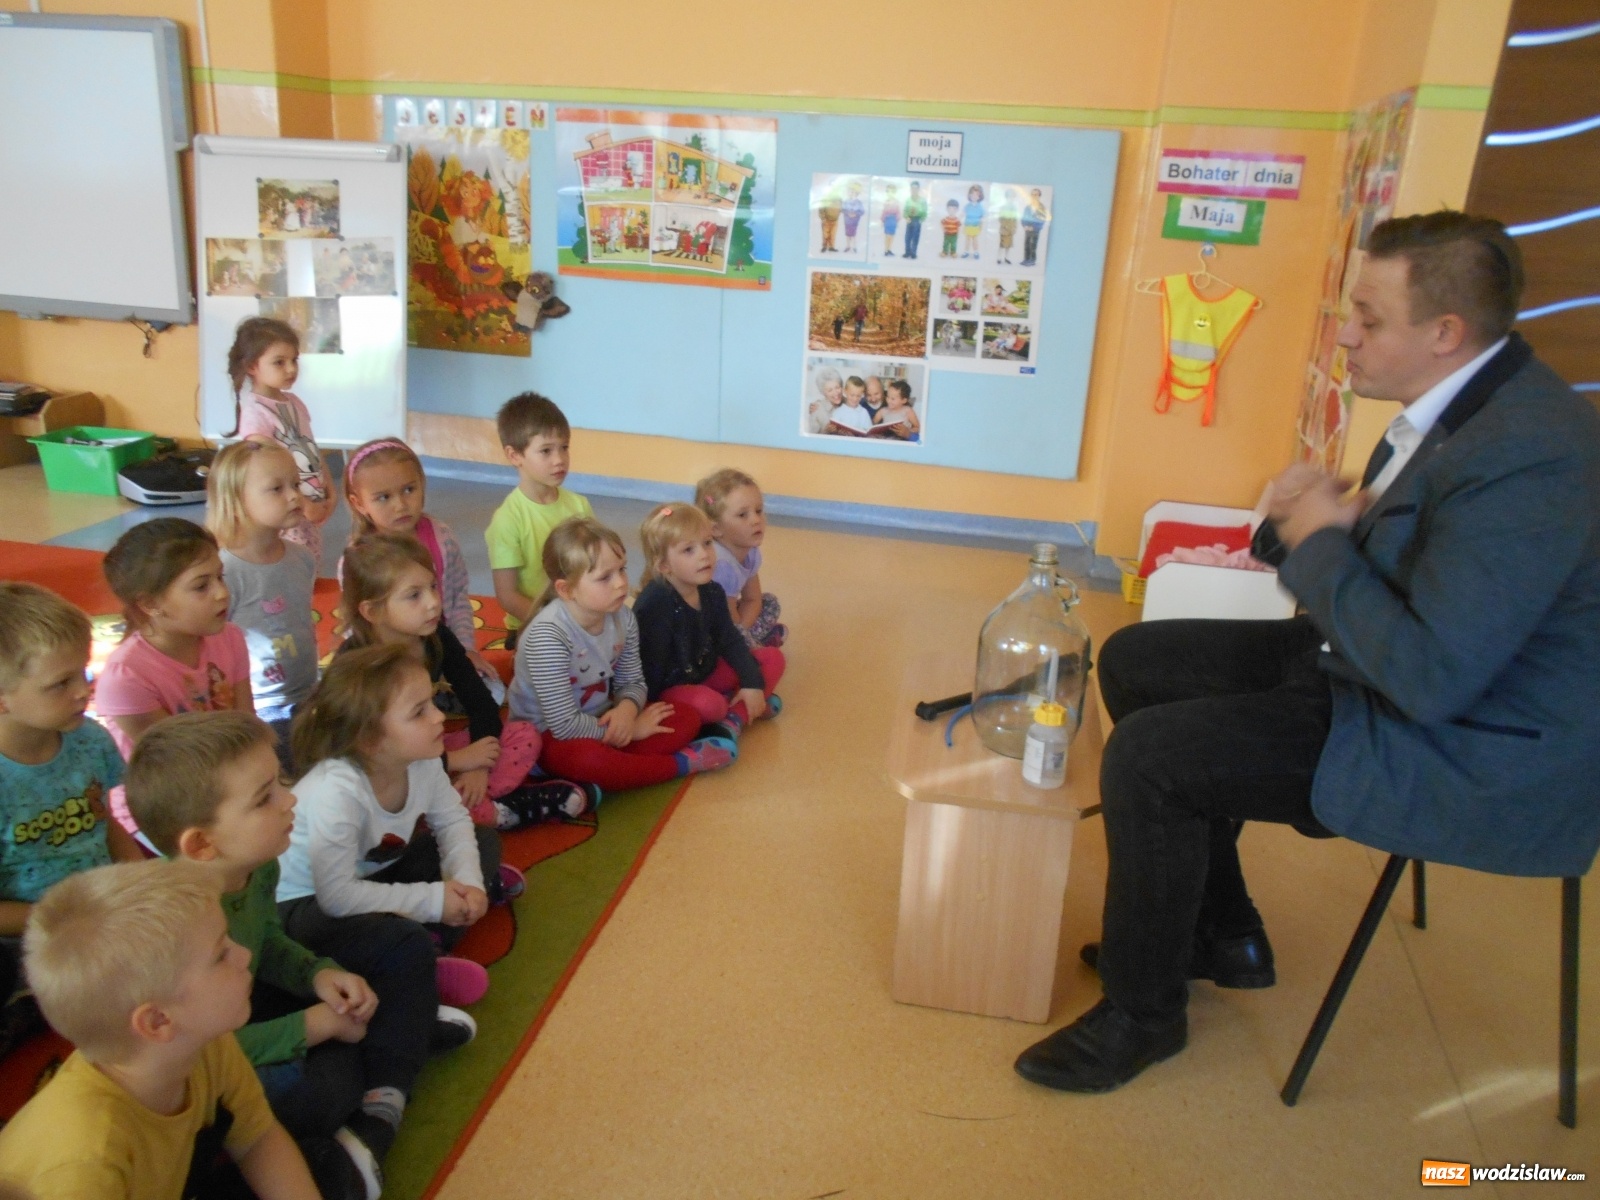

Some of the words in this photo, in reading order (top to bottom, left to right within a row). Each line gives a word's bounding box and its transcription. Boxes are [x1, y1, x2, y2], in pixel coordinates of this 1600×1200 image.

[919, 136, 951, 150] moja
[909, 154, 958, 167] rodzina
[1168, 163, 1239, 181] Bohater
[1254, 168, 1293, 184] dnia
[1190, 205, 1235, 226] Maja
[14, 797, 90, 843] SCOOBY
